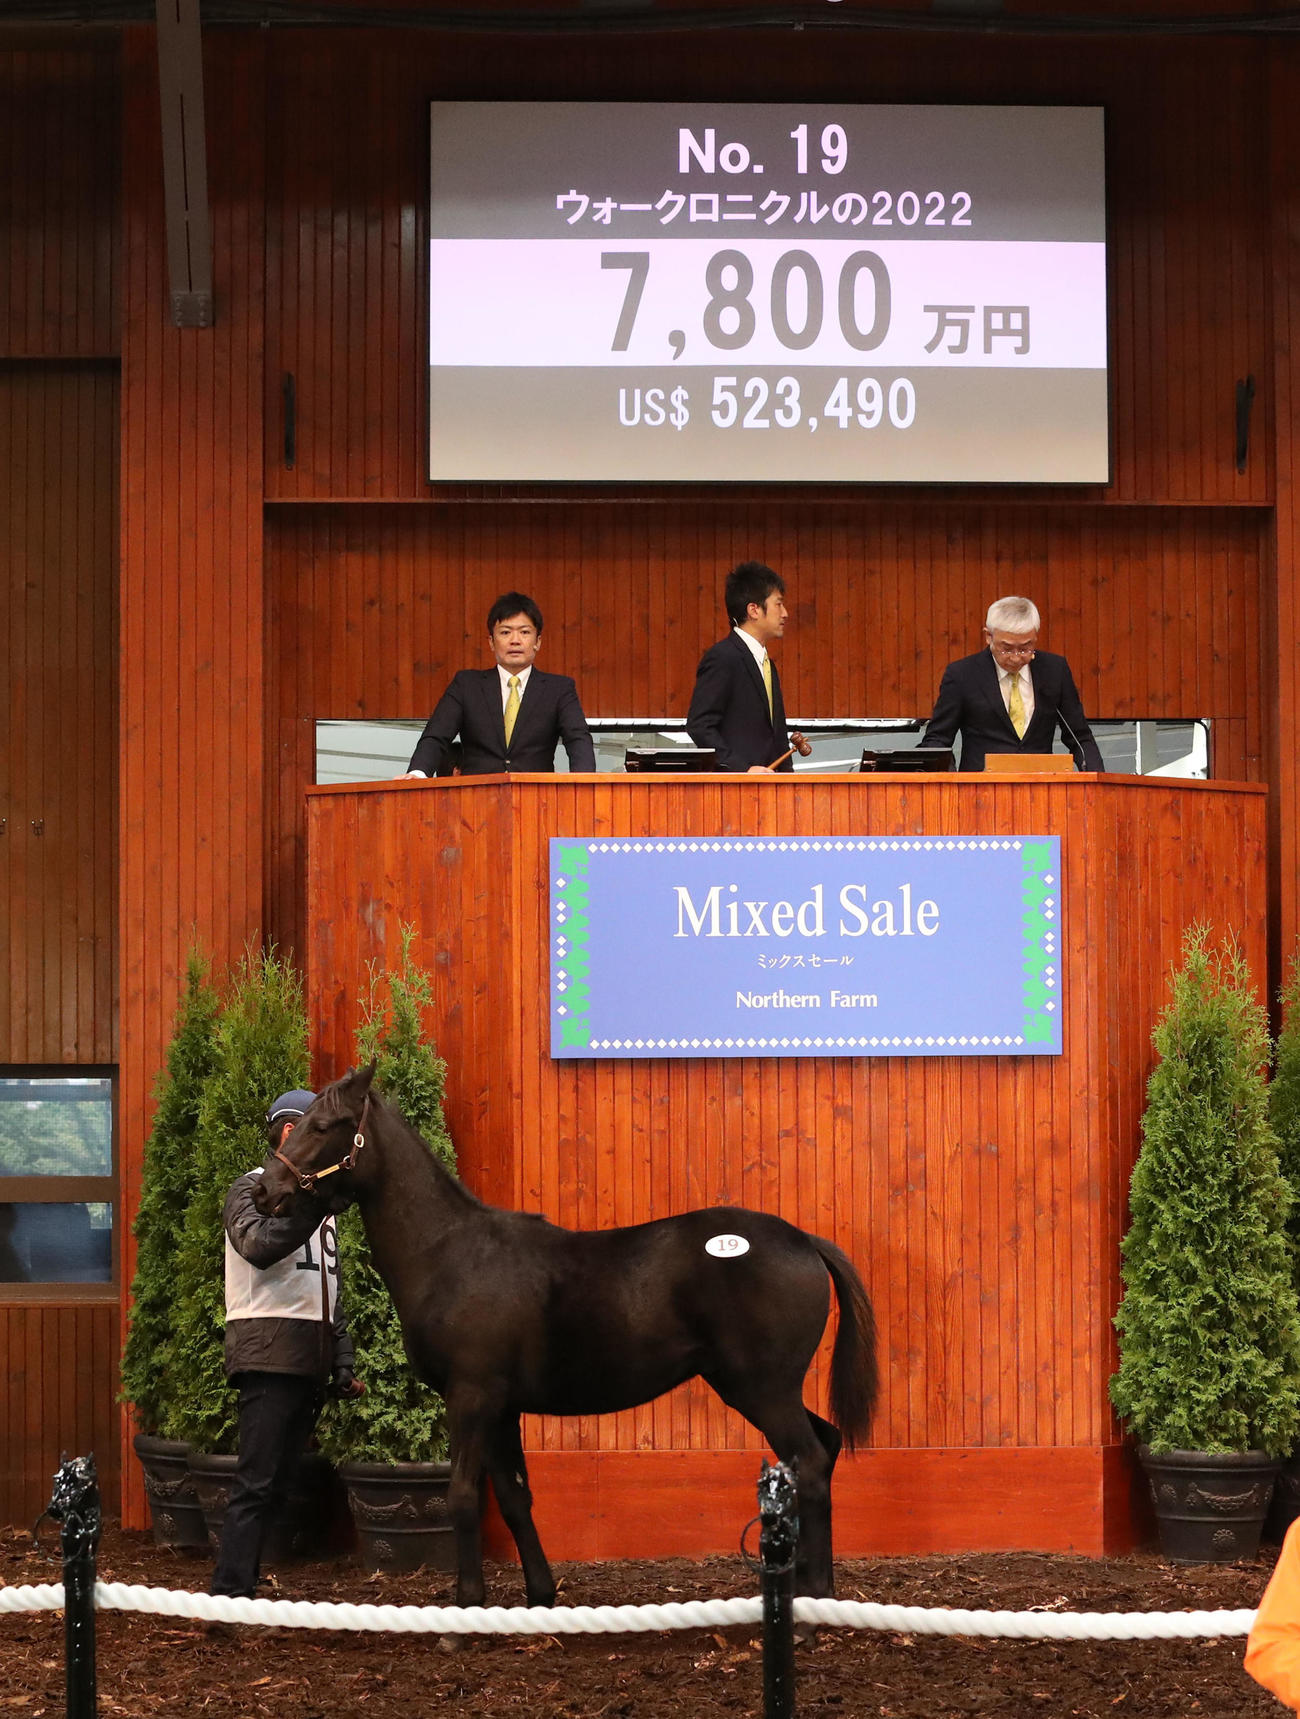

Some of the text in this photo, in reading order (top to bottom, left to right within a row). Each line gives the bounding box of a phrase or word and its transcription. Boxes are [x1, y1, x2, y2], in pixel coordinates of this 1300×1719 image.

[679, 123, 848, 175] No. 19
[556, 189, 973, 226] ウォークロニクルの2022
[600, 248, 1032, 361] 7,800 万円
[619, 376, 917, 432] US$ 523,490
[672, 882, 940, 938] Mixed Sale
[757, 953, 855, 969] ミックスセール
[736, 989, 878, 1009] Northern Farm
[718, 1239, 739, 1251] 19
